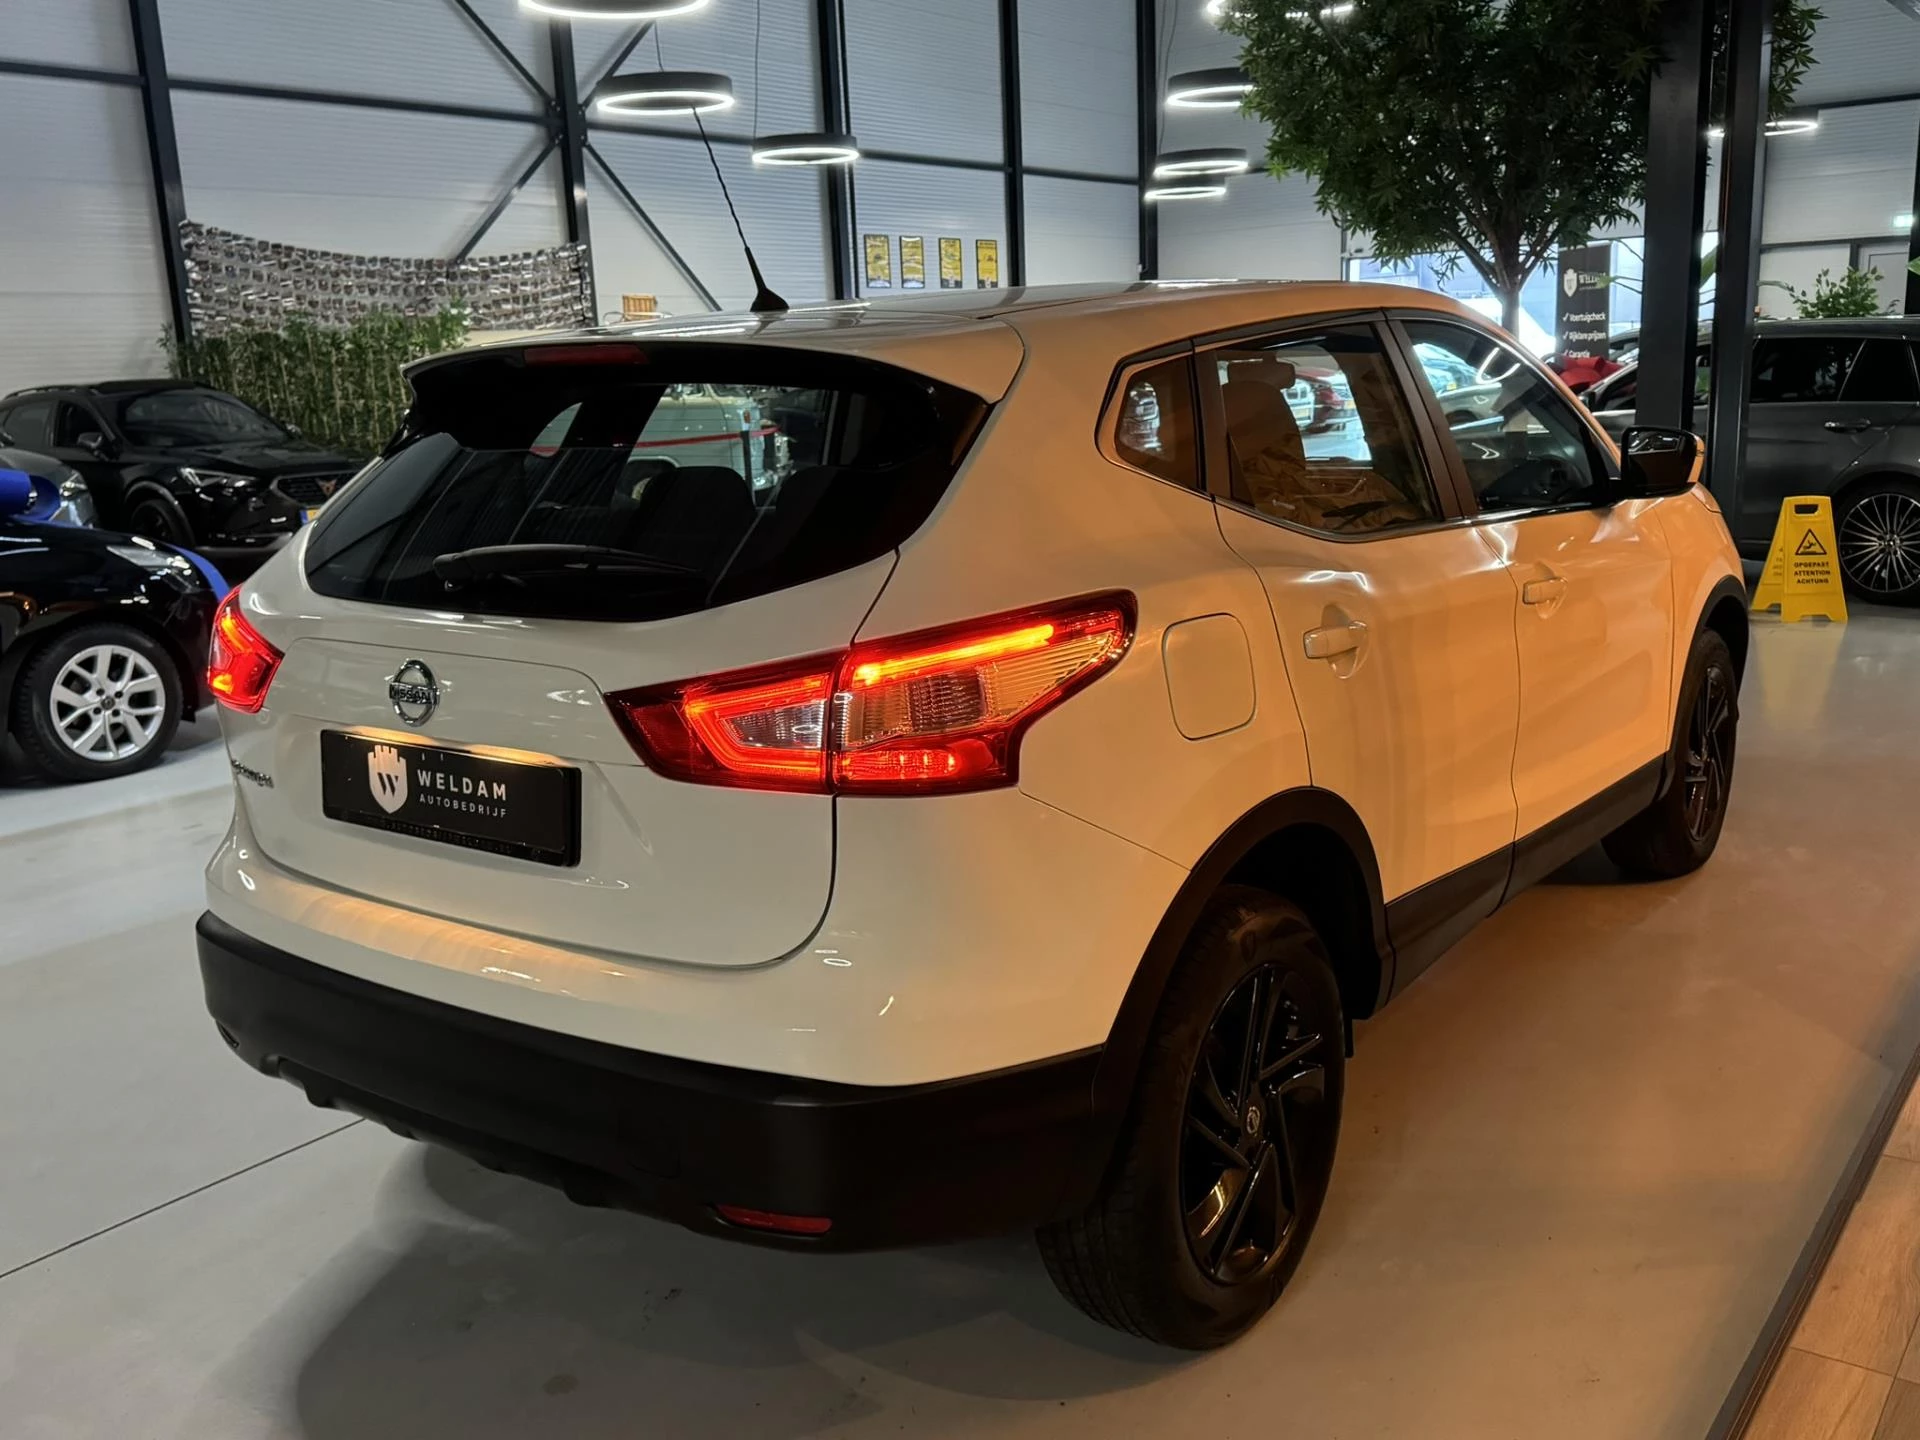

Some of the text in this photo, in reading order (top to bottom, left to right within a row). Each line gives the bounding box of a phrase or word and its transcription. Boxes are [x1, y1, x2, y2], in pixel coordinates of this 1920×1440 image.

[391, 683, 435, 705] NISSAN
[377, 772, 399, 797] W
[417, 769, 507, 801] WELDAM
[419, 793, 507, 818] AUTOBEDRIJF
